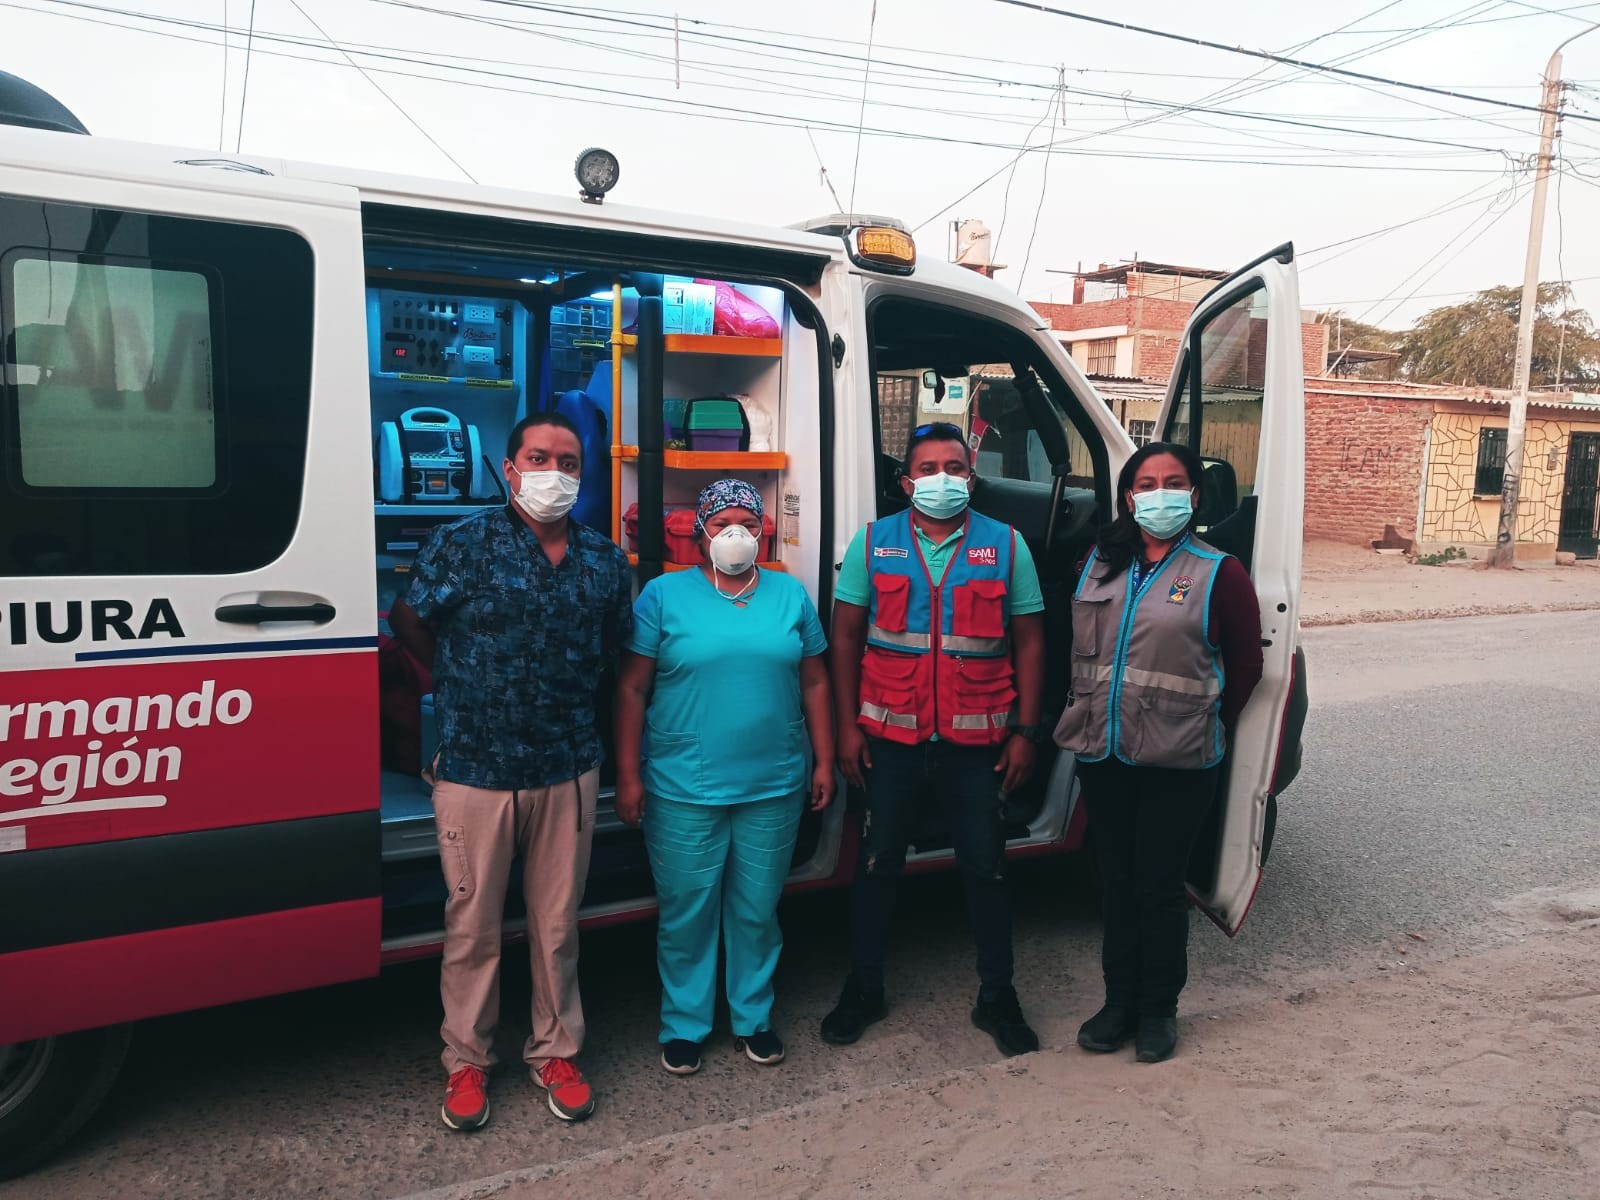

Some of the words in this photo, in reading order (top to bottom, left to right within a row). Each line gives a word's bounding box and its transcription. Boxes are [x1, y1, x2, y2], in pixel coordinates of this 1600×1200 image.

[968, 547, 996, 558] SAMU
[0, 598, 186, 645] IURA
[0, 680, 252, 742] rmando
[0, 736, 182, 804] egión
